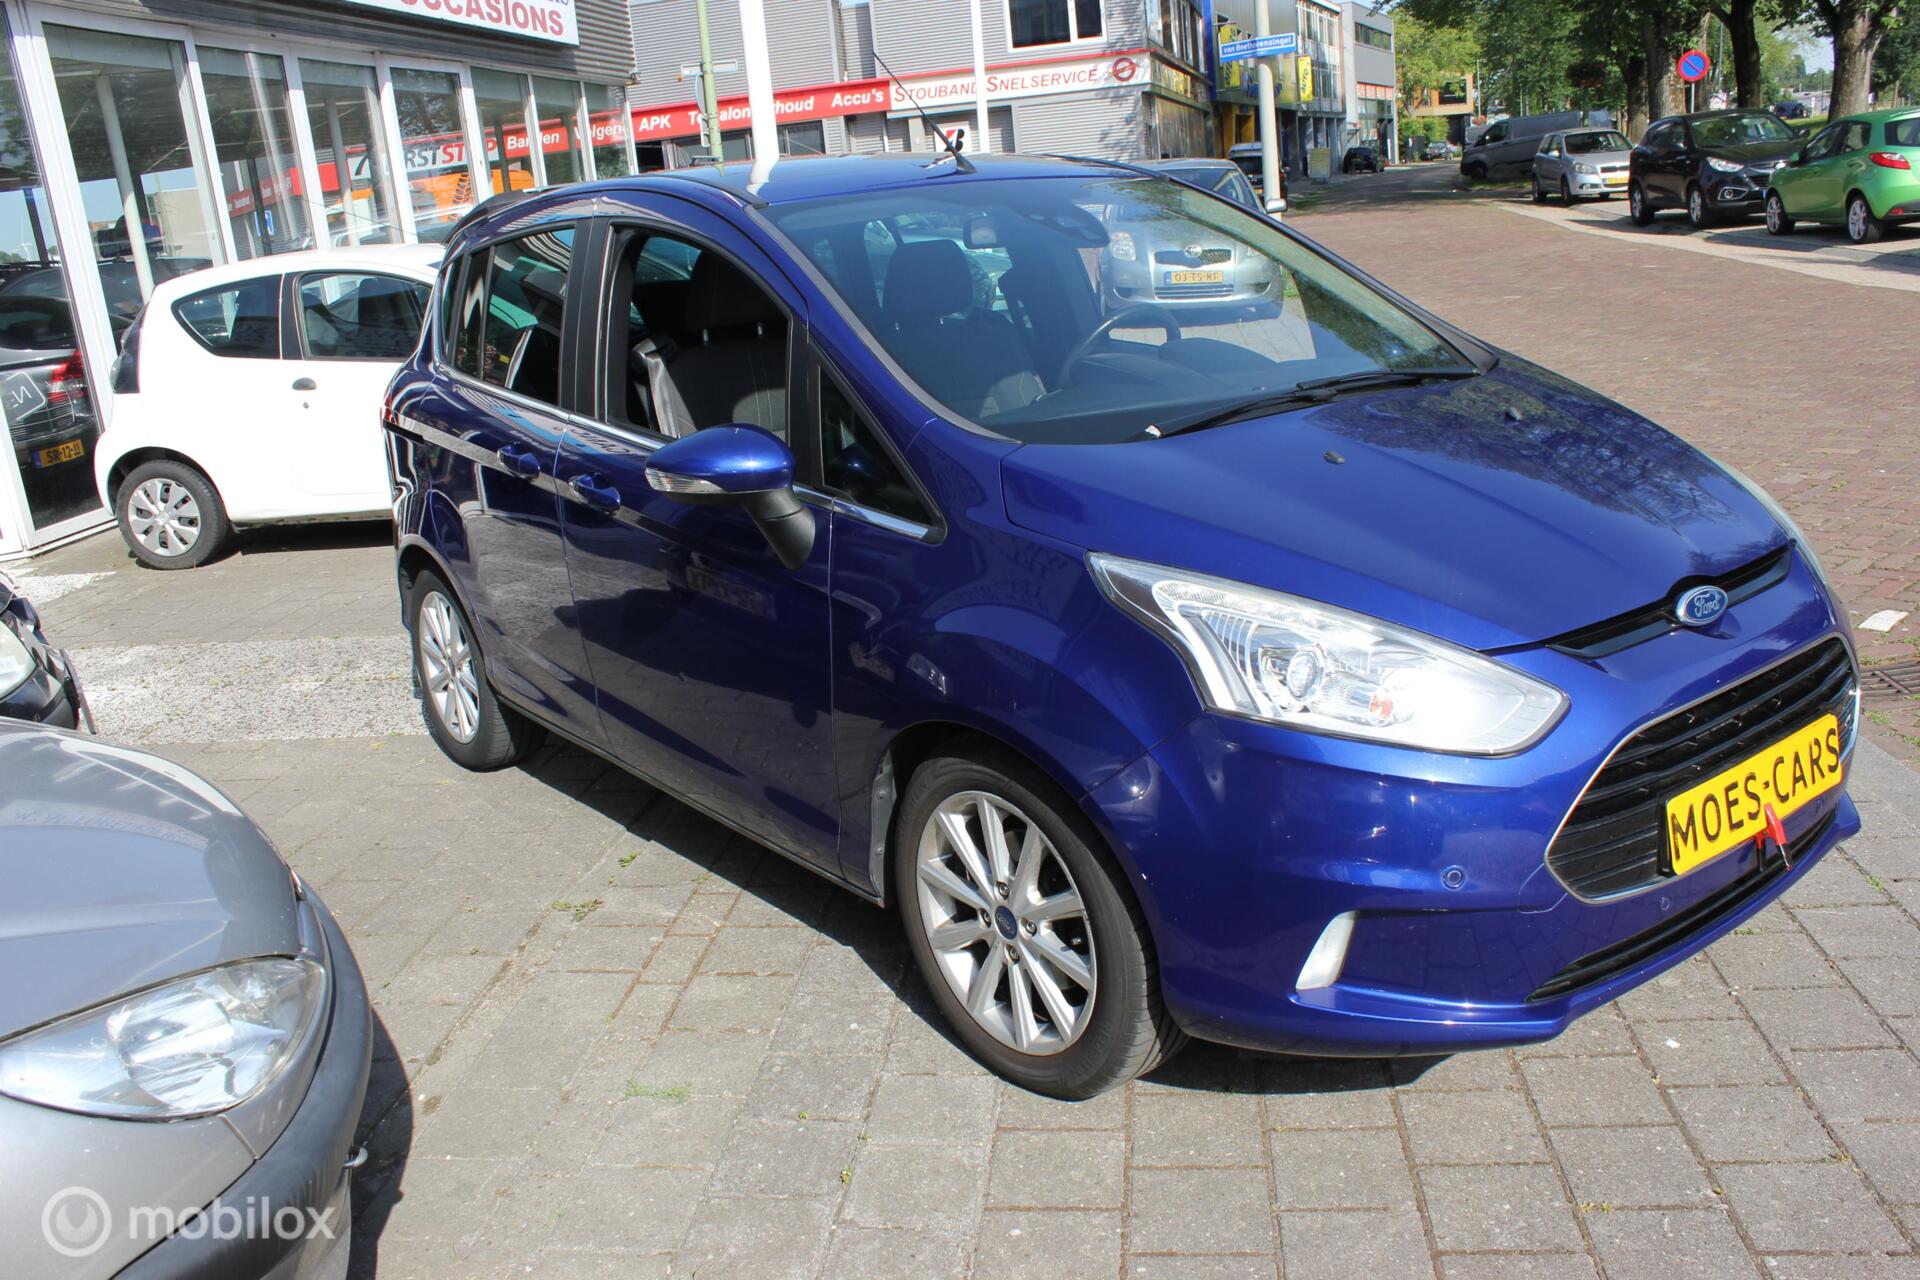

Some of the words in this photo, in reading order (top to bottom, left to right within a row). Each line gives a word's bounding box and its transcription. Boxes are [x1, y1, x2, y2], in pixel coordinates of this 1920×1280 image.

[402, 0, 564, 36] CASIONS
[1224, 45, 1235, 53] van
[894, 80, 977, 102] STOUBAND
[986, 68, 1097, 93] SNELSERVICE
[507, 130, 560, 150] Baen
[574, 122, 622, 142] Vlgen
[639, 114, 671, 132] APK
[832, 89, 884, 108] Accu's
[1694, 592, 1720, 618] Ford
[1671, 727, 1840, 861] MOES-CARS
